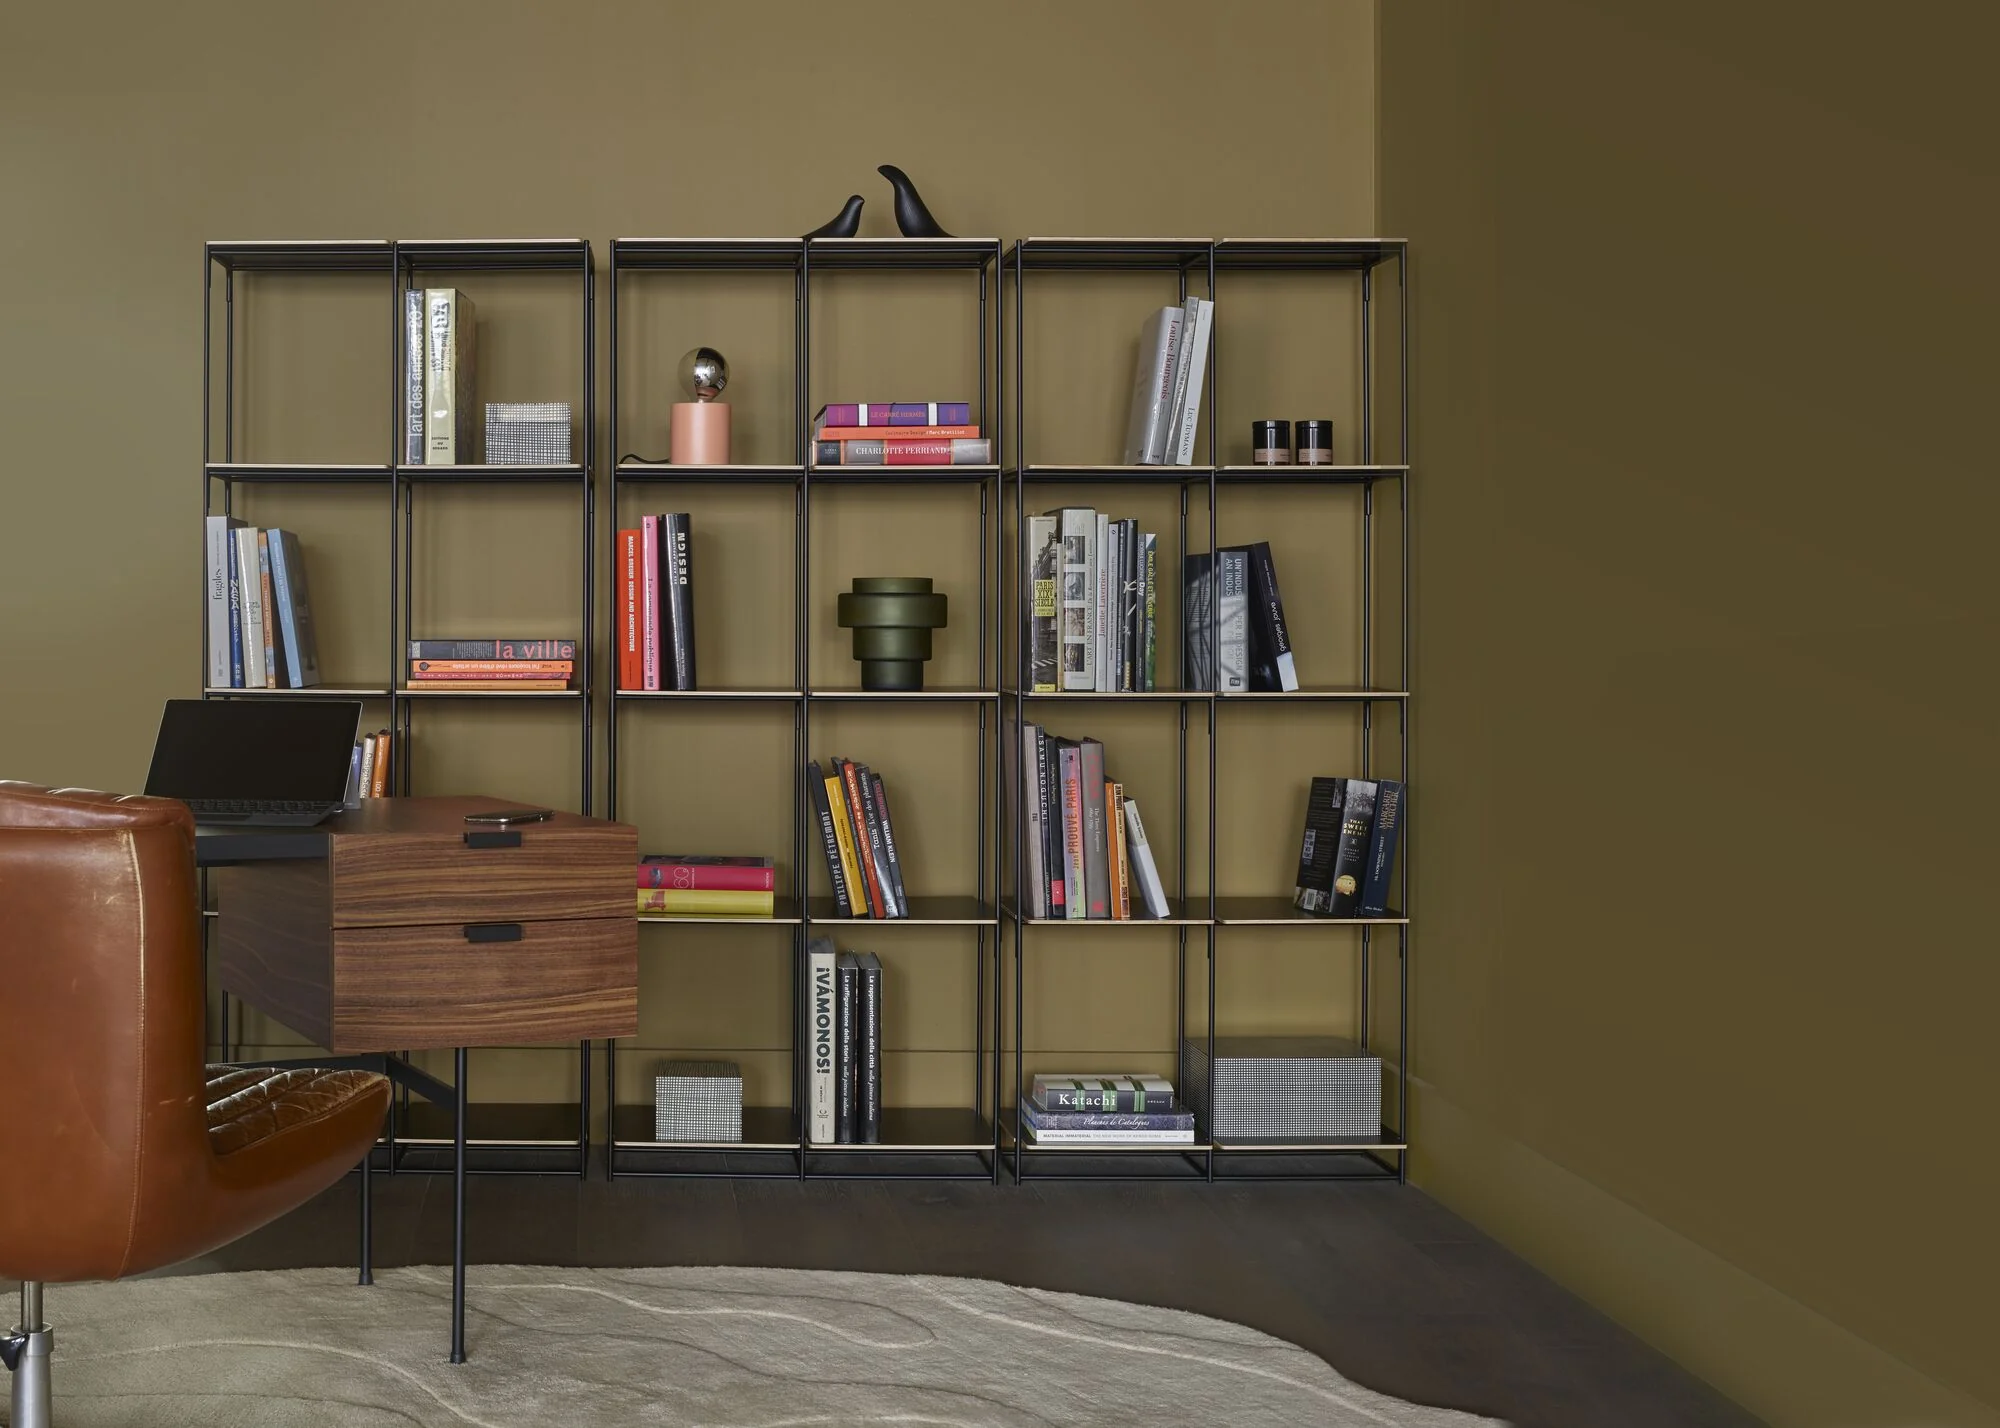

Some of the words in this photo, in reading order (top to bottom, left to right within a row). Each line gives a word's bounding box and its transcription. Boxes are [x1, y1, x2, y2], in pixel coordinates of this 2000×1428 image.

[1166, 319, 1180, 351] Louise
[1161, 353, 1175, 400] Bourgeois
[411, 385, 423, 409] des
[855, 447, 904, 455] CHARLOTTE
[905, 446, 946, 455] PERRIAND
[677, 532, 688, 585] DESIGN
[1226, 558, 1233, 570] AN
[212, 568, 224, 600] fragiles
[1035, 581, 1054, 590] PARIS
[1098, 568, 1106, 608] Laverrière
[1137, 581, 1146, 597] Day
[1098, 610, 1106, 638] Janette
[1270, 601, 1281, 621] jouve
[495, 640, 513, 659] la
[523, 640, 573, 659] ville
[1086, 634, 1093, 645] EN
[1275, 623, 1287, 652] georges
[1038, 735, 1046, 769] ISAMU
[860, 772, 872, 799] pharaons
[1040, 771, 1048, 820] NOGUCHI
[1065, 778, 1077, 808] PARIS
[865, 800, 873, 812] des
[1379, 789, 1392, 830] MARGARET
[1386, 790, 1400, 829] THATCHER
[821, 810, 840, 859] PÉTREMANT
[871, 828, 880, 850] Tanis
[882, 819, 894, 846] WILLIAM
[1064, 813, 1079, 854] PROUVÉ
[1343, 823, 1367, 831] SWEET
[1343, 829, 1367, 837] ENEMY
[887, 845, 896, 863] KLEIN
[832, 863, 848, 906] PHILIPPE
[844, 975, 850, 983] La
[868, 975, 875, 983] La
[816, 967, 834, 1074] ¡VÁMONOS!
[1059, 1093, 1116, 1105] Katachi
[1109, 1115, 1117, 1125] de
